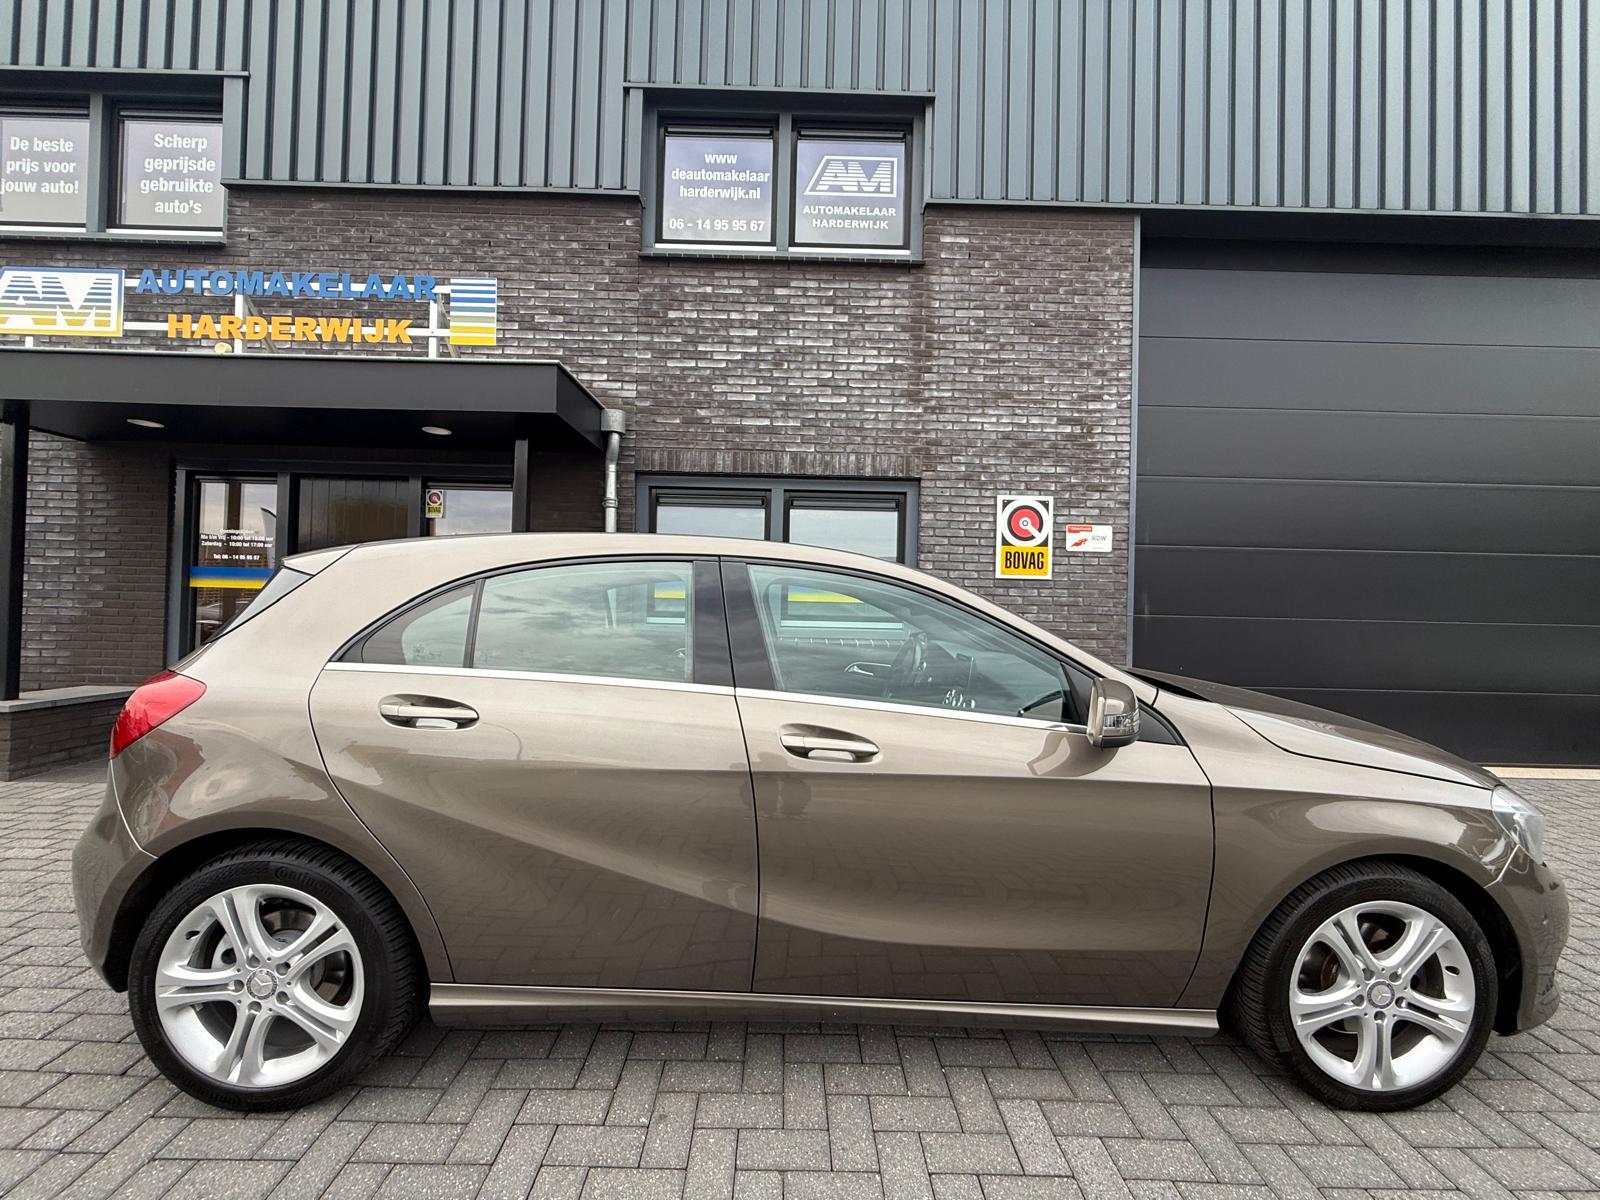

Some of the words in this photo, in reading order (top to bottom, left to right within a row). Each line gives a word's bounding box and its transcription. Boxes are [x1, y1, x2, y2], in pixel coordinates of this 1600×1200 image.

[10, 137, 29, 151] De
[33, 138, 74, 152] beste
[153, 133, 208, 153] Scherp
[6, 158, 39, 175] prijs
[43, 161, 76, 173] voor
[144, 157, 216, 174] geprijsde
[704, 154, 737, 165] www
[671, 167, 770, 182] deautomakelaar
[815, 160, 892, 193] AM
[0, 180, 37, 195] jouw
[41, 180, 79, 194] auto!
[140, 177, 214, 194] gebruikte
[679, 185, 761, 201] harderwijk.nl
[154, 199, 202, 215] auto's
[802, 205, 897, 217] AUTOMAKELAAR
[669, 218, 684, 230] 06
[696, 219, 711, 231] 14
[713, 219, 729, 231] 95
[732, 219, 747, 232] 95
[749, 220, 765, 232] 67
[812, 218, 889, 230] HARDERWIJK
[135, 268, 438, 301] AUTOMAKELAAR
[0, 275, 112, 327] AM
[167, 313, 414, 344] HARDERWIJK
[1004, 551, 1045, 570] BOVAG
